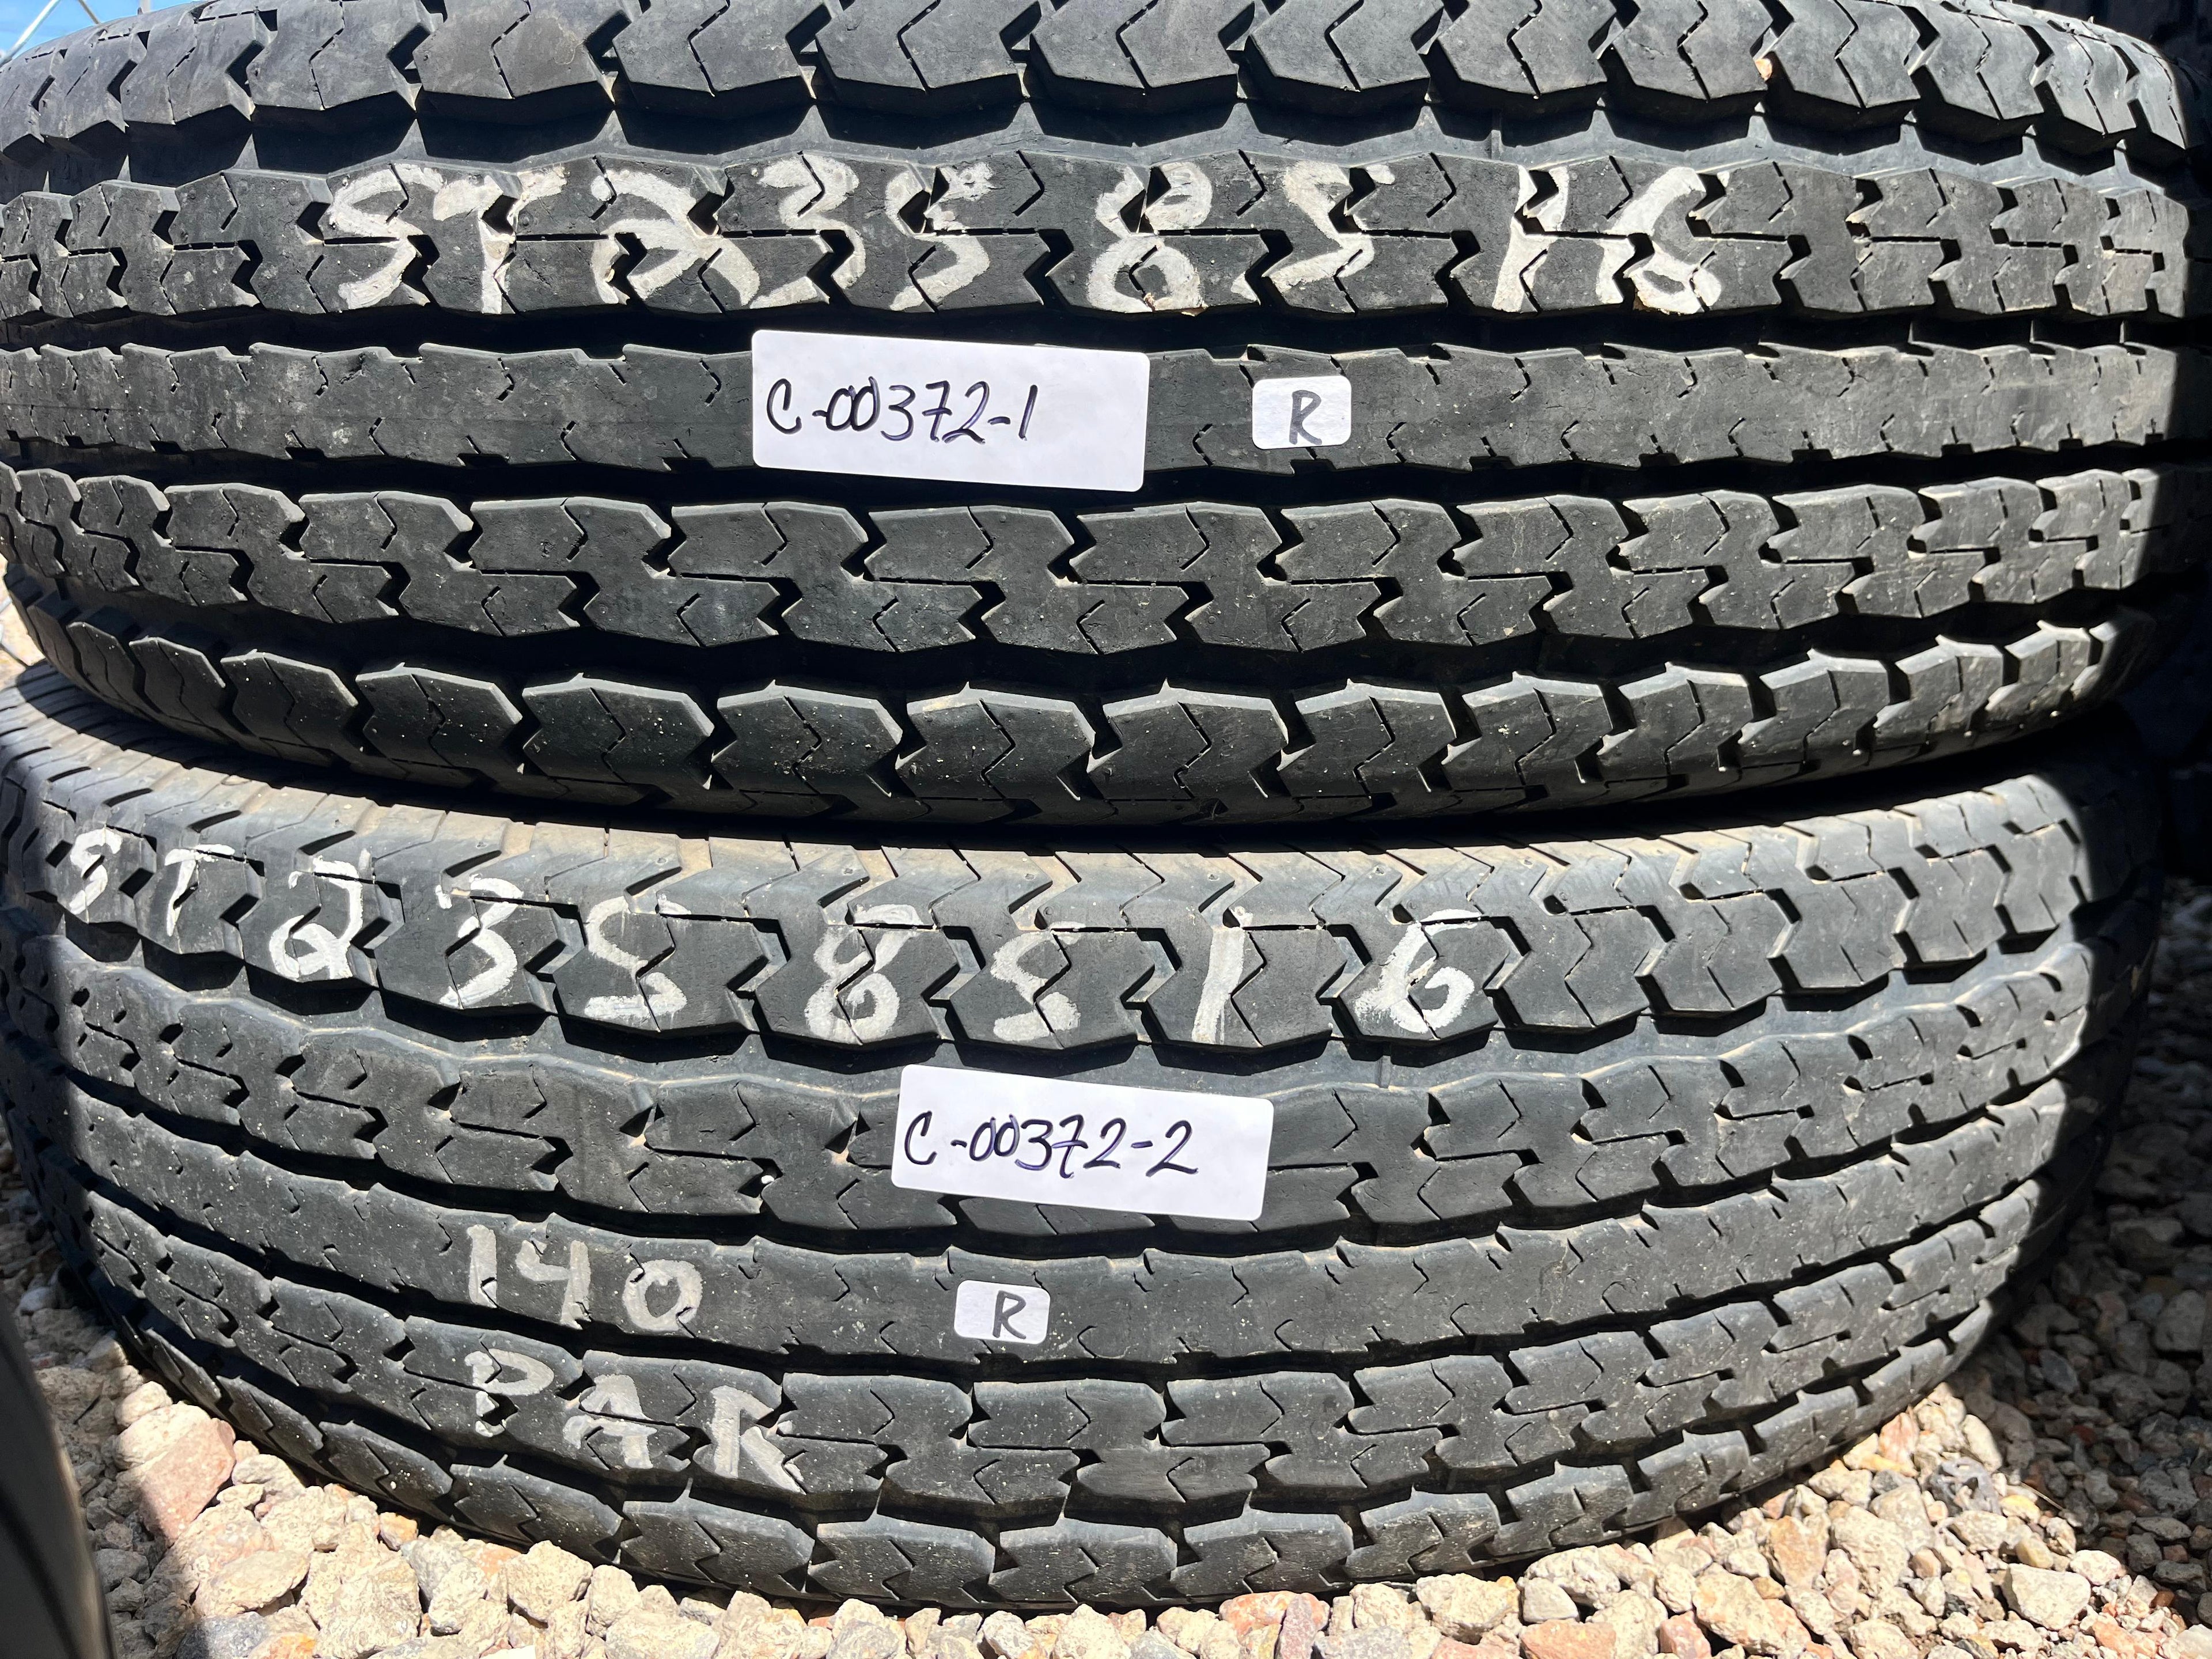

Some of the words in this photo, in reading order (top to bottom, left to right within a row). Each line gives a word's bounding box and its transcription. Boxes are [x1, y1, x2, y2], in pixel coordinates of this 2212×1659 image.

[766, 376, 1037, 444] C-00372-1
[1289, 389, 1323, 446] R
[904, 1110, 1199, 1179] C-00372-2
[467, 1224, 703, 1332] 140
[992, 1290, 1027, 1340] R
[464, 1348, 806, 1495] PAR
